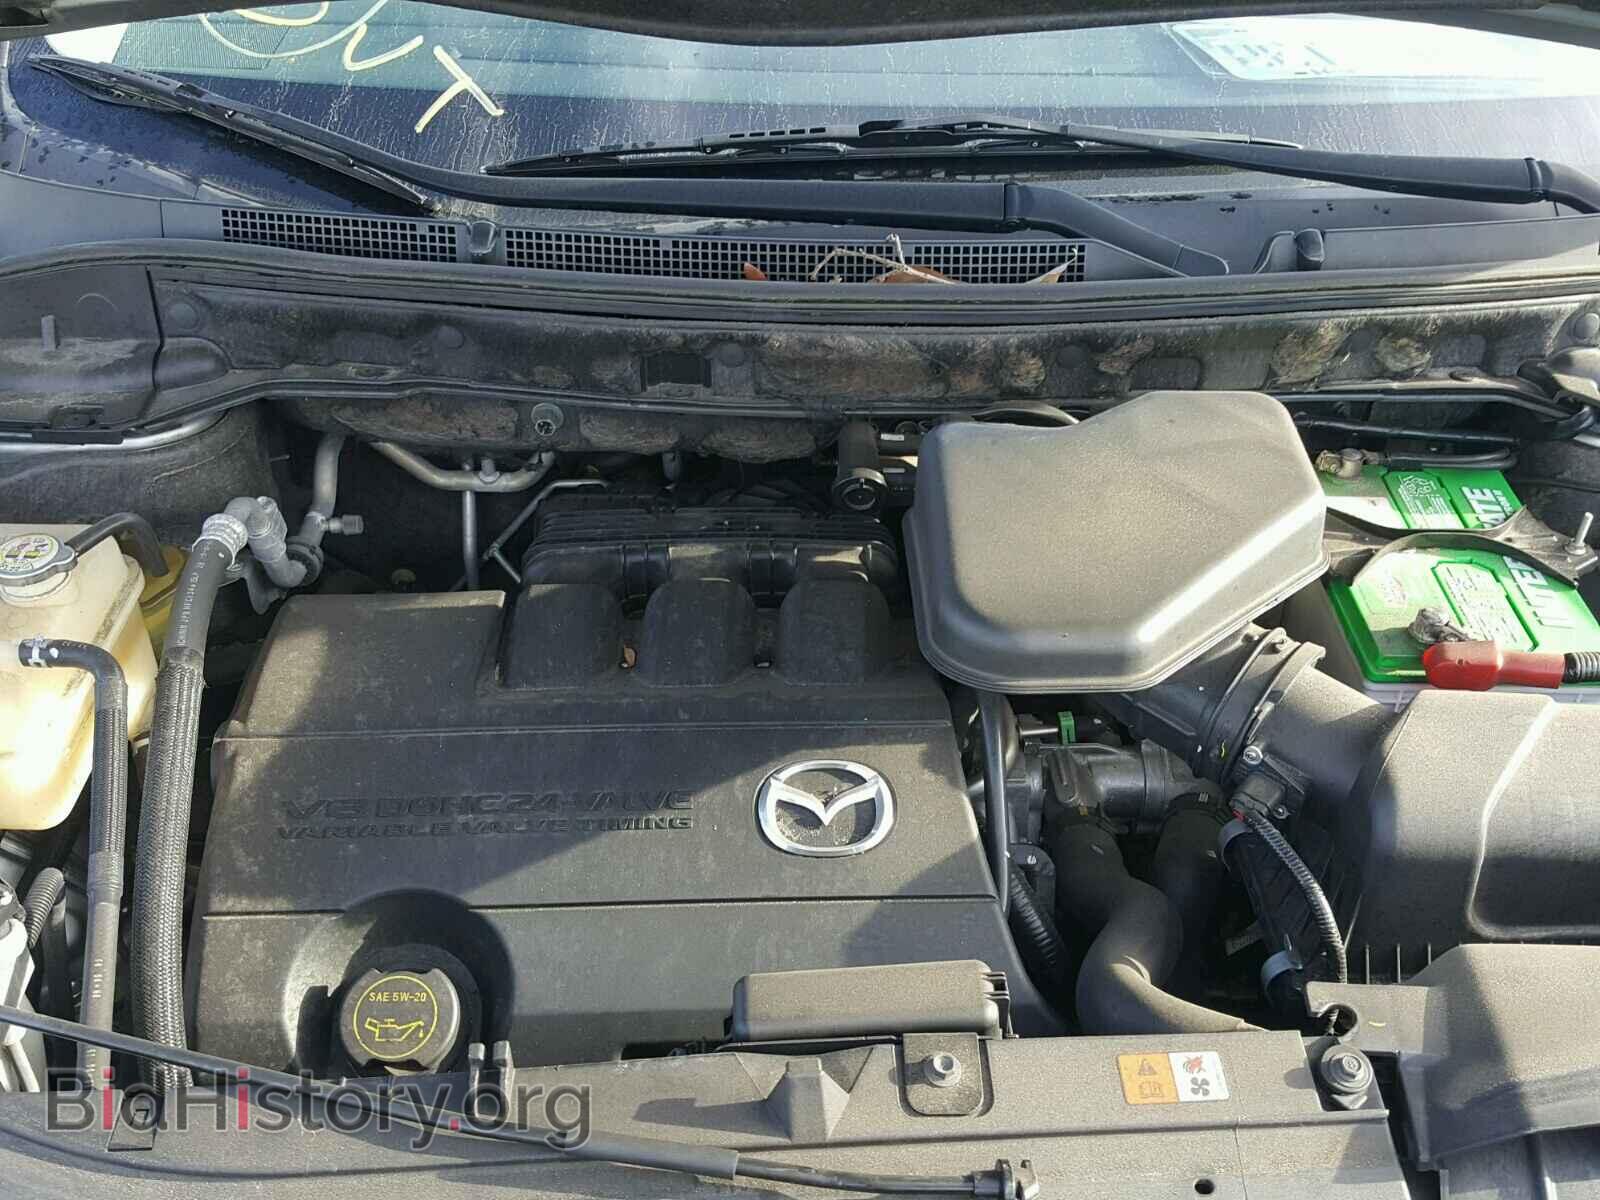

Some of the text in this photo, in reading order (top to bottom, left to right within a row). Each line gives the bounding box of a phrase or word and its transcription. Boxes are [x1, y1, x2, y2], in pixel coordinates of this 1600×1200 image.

[277, 816, 696, 840] VARIABLE VALVE TIMING
[369, 992, 427, 1002] SAE 5W-20
